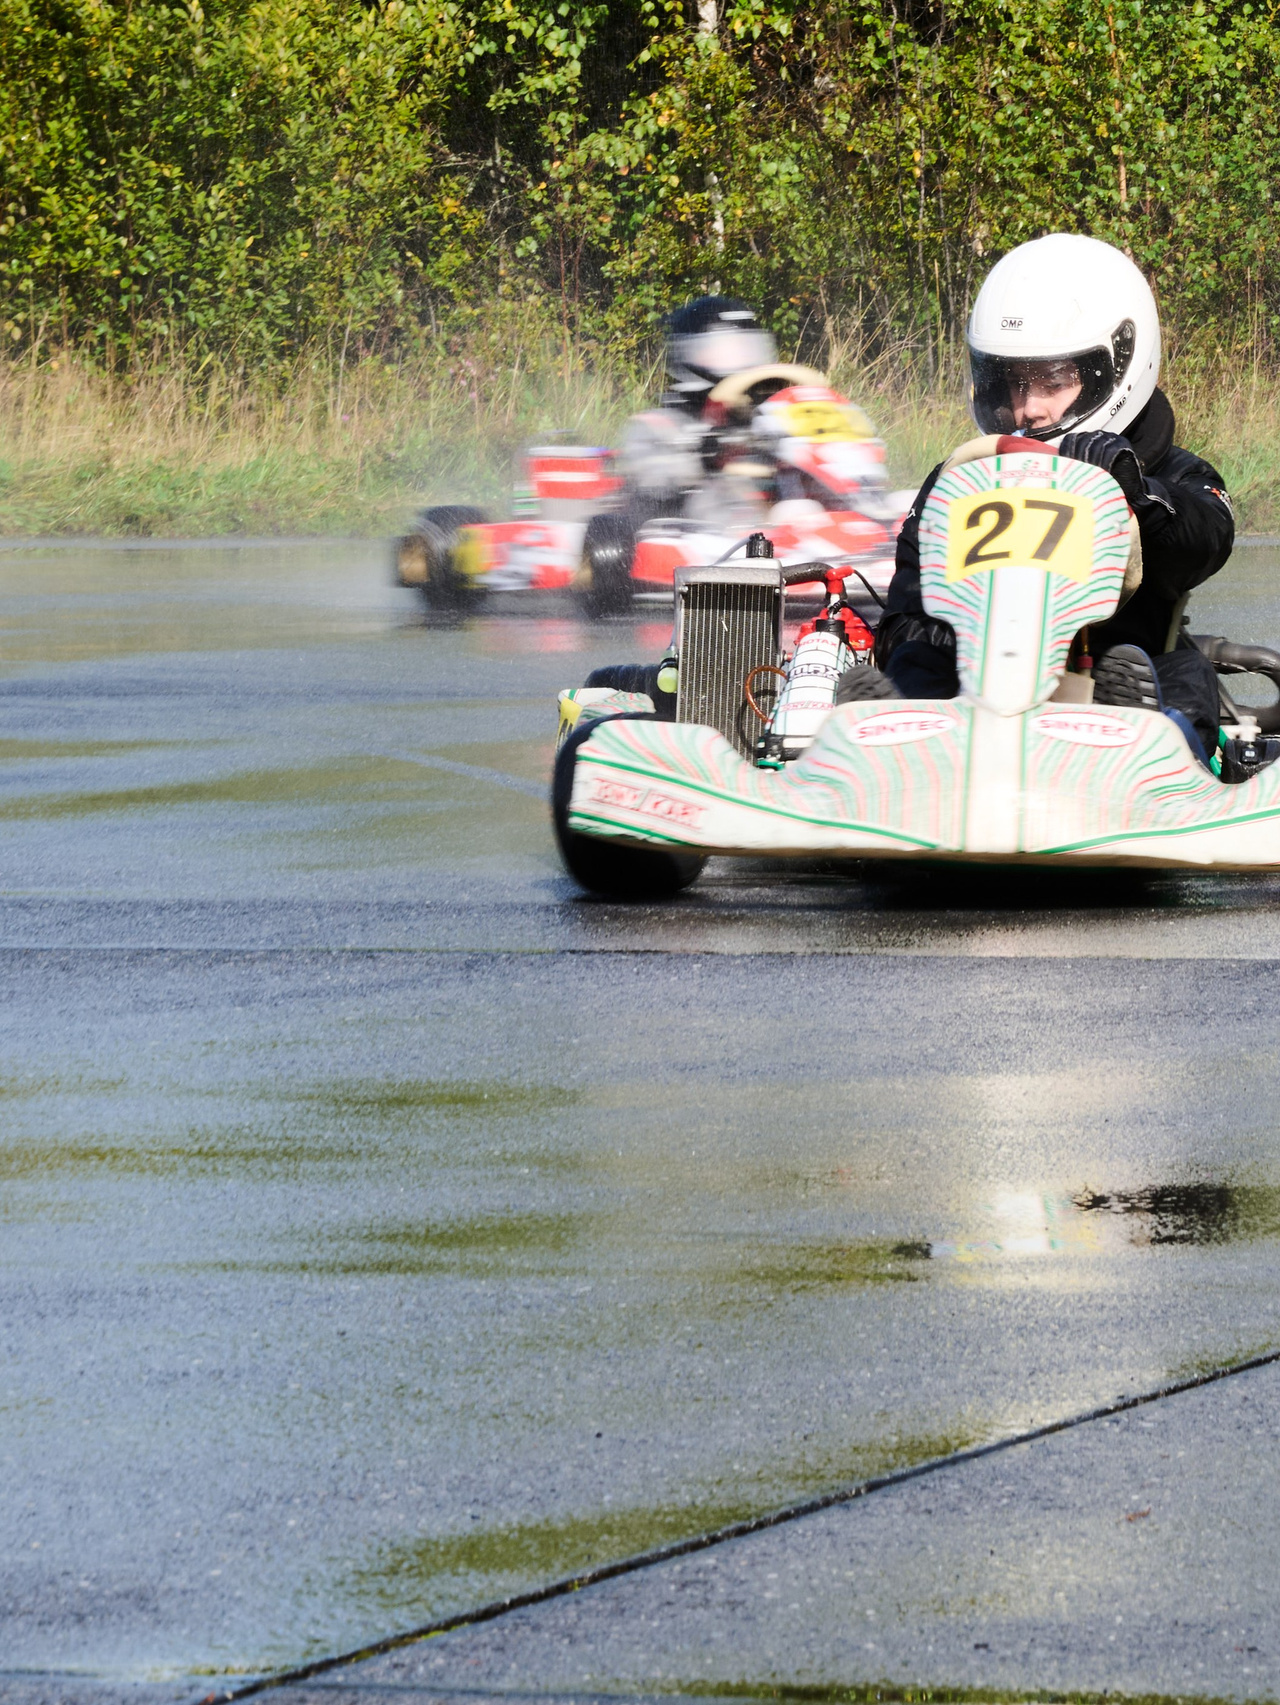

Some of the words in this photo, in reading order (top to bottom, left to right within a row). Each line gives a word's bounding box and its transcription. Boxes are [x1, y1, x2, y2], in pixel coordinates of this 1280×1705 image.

[1000, 319, 1024, 329] OMP
[1109, 396, 1127, 417] OMP
[963, 499, 1077, 568] 27
[790, 663, 843, 679] MAX
[857, 719, 947, 739] SINTEC
[1039, 718, 1132, 740] SINTEC
